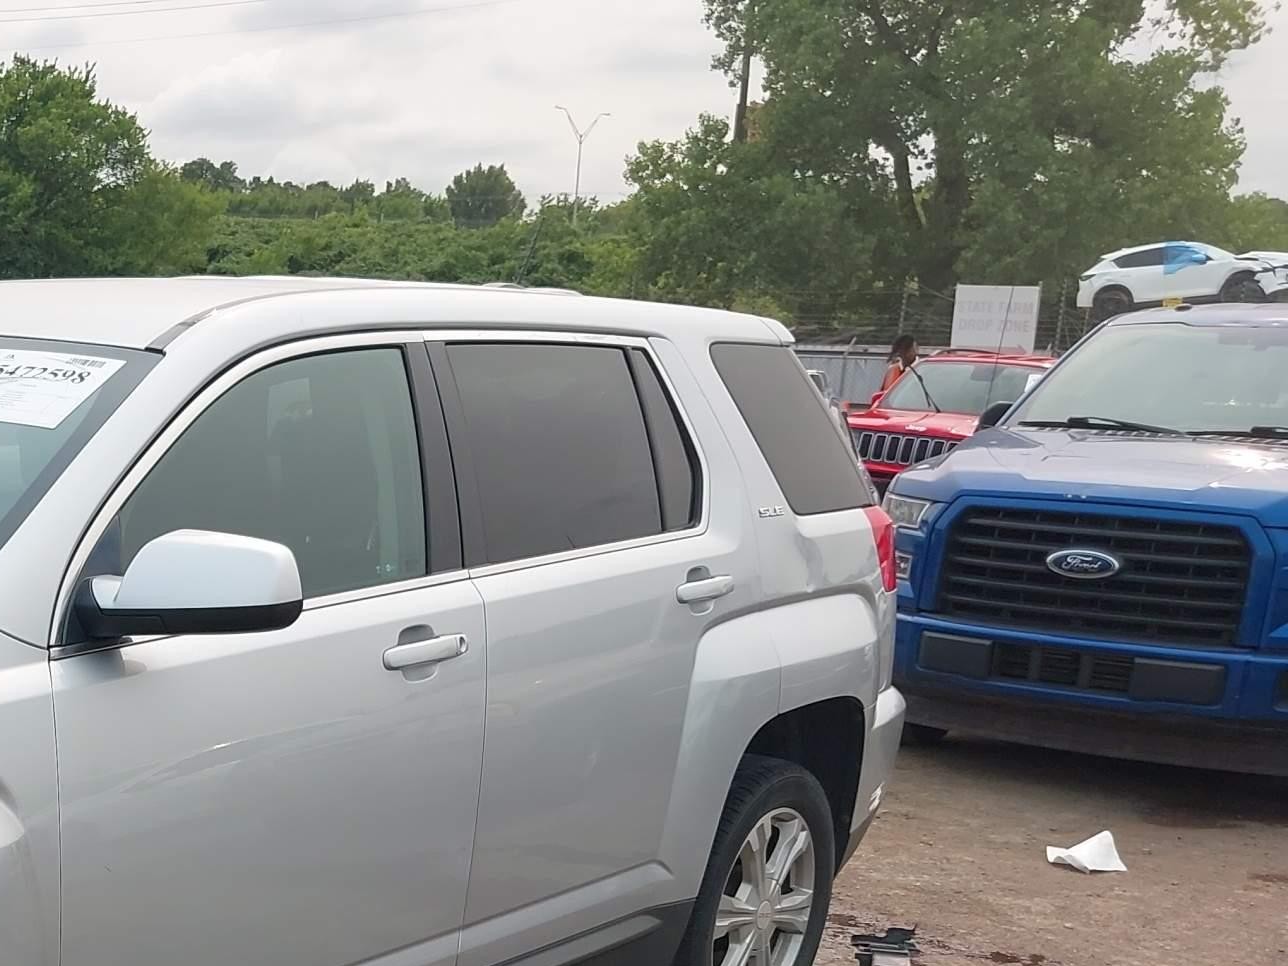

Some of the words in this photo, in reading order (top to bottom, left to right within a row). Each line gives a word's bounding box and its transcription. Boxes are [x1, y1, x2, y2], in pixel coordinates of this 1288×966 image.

[959, 318, 993, 330] DROP
[758, 504, 785, 518] SLE
[1061, 555, 1102, 569] Ford
